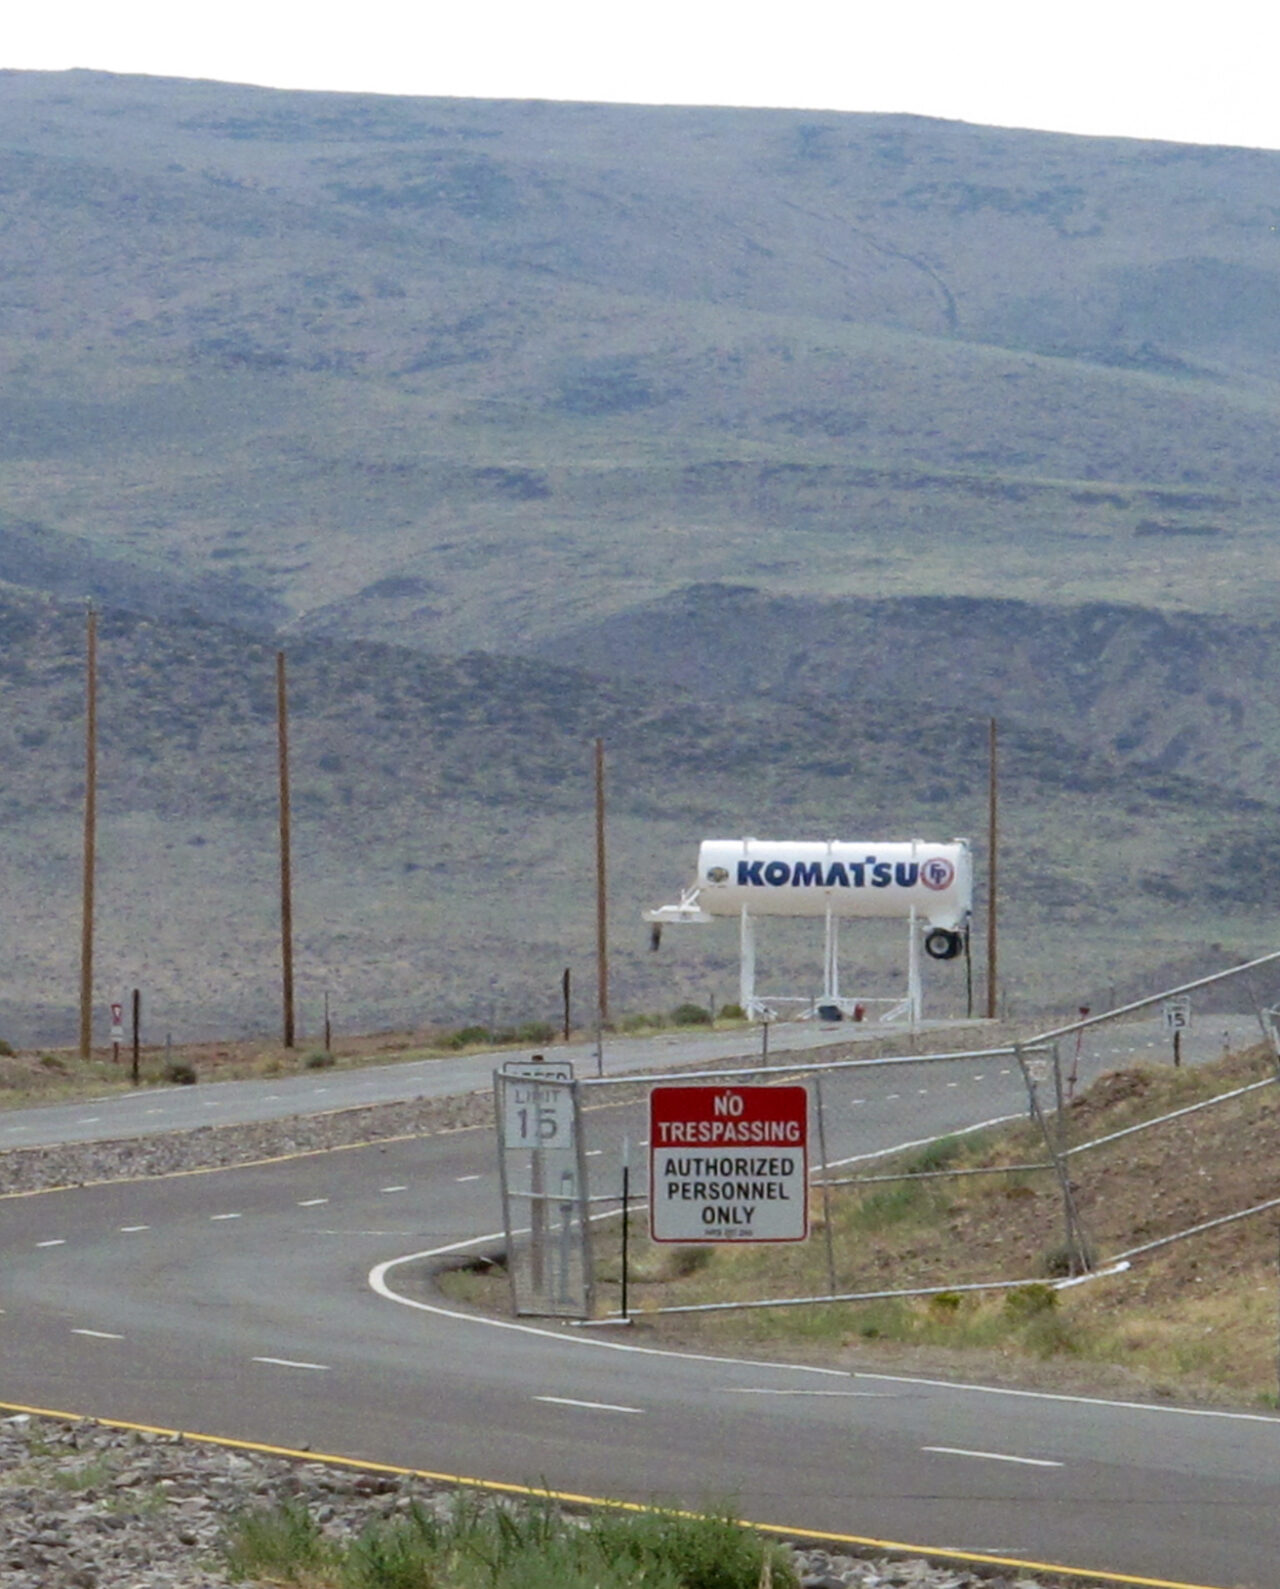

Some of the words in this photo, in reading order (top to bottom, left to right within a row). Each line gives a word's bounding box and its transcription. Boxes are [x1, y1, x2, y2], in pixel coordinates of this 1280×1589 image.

[737, 856, 919, 888] KOMATSU
[714, 1095, 744, 1117] NO
[517, 1109, 557, 1138] 15
[658, 1121, 801, 1142] TRESPASSING
[664, 1158, 795, 1177] AUTHORIZED
[667, 1182, 790, 1200] PERSONNEL
[701, 1206, 756, 1225] ONLY
